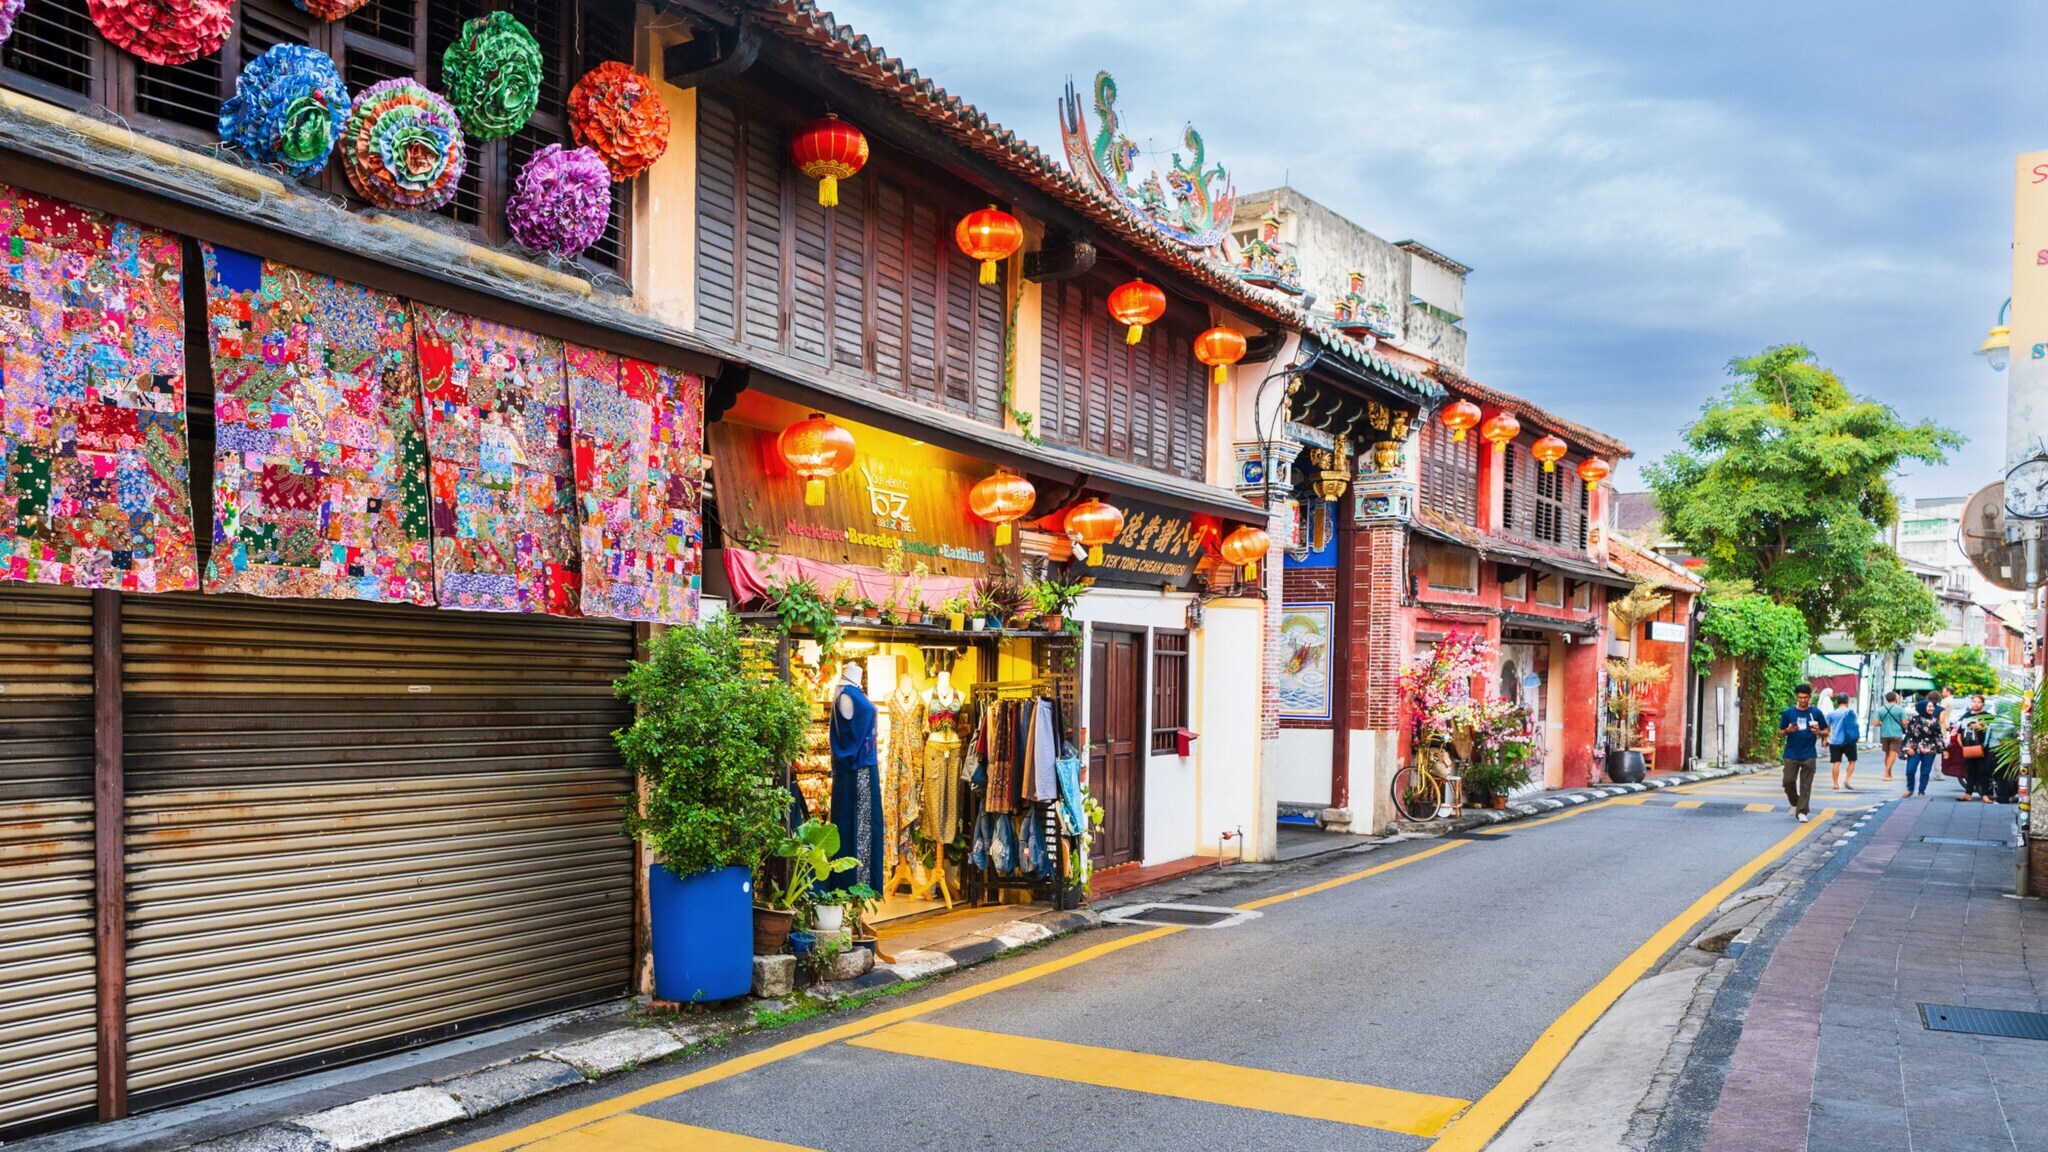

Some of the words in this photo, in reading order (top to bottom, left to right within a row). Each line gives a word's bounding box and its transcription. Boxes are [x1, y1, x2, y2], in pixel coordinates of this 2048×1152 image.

[786, 517, 846, 542] Necklace
[848, 527, 899, 550] Bracelet
[901, 536, 940, 557] Anklet
[942, 543, 985, 564] EarRing
[1106, 507, 1208, 558] 德堂謝公司
[1102, 553, 1121, 569] TEK
[1118, 556, 1140, 571] TONG
[1137, 559, 1164, 574] CHEAH
[1160, 562, 1188, 577] KONGSI
